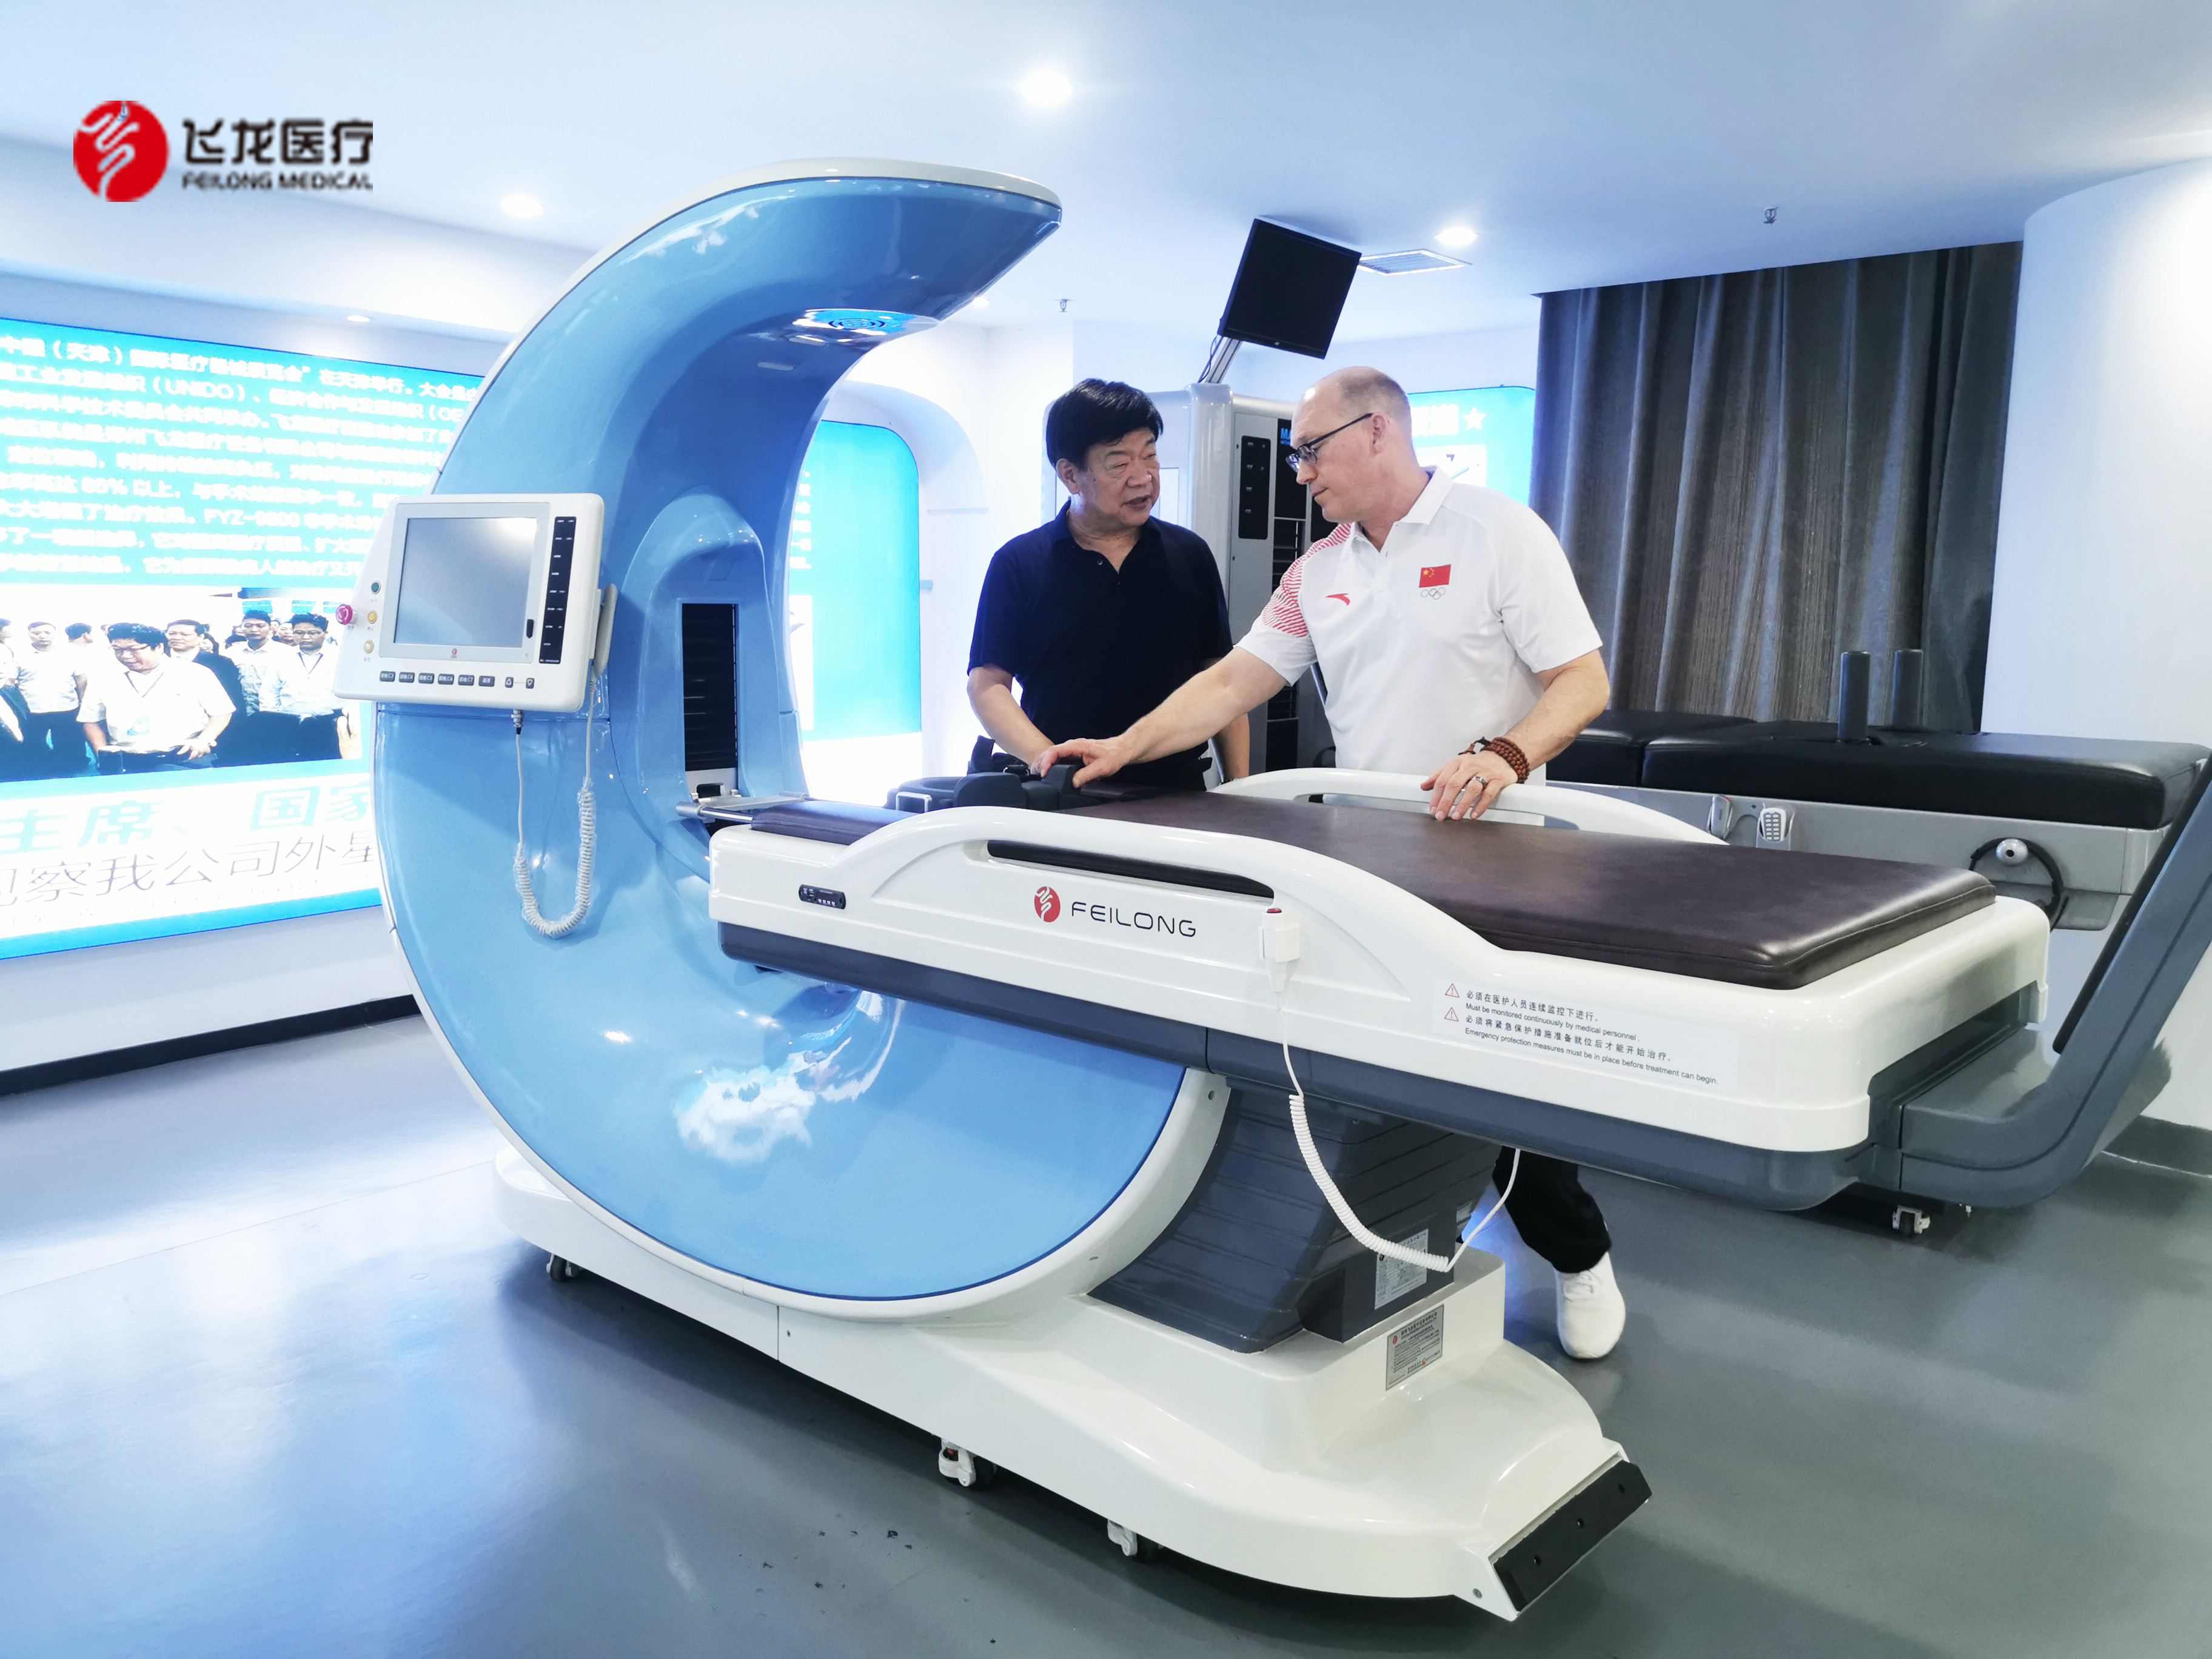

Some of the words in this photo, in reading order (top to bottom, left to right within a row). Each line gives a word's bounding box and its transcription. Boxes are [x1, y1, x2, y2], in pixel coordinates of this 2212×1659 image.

[1071, 901, 1196, 937] FEILONG
[1466, 1002, 1480, 1012] Must
[1492, 1008, 1522, 1020] monitored
[1524, 1014, 1563, 1028] continuously
[1566, 1022, 1574, 1030] by
[1575, 1024, 1601, 1034] medical
[1466, 1027, 1499, 1041] Emergency
[1501, 1034, 1532, 1047] protection
[1533, 1042, 1564, 1053] measures
[1566, 1048, 1583, 1057] must
[1602, 1055, 1620, 1065] place
[1622, 1059, 1644, 1070] before
[1646, 1064, 1679, 1077] treatment
[1696, 1073, 1718, 1085] begin.
